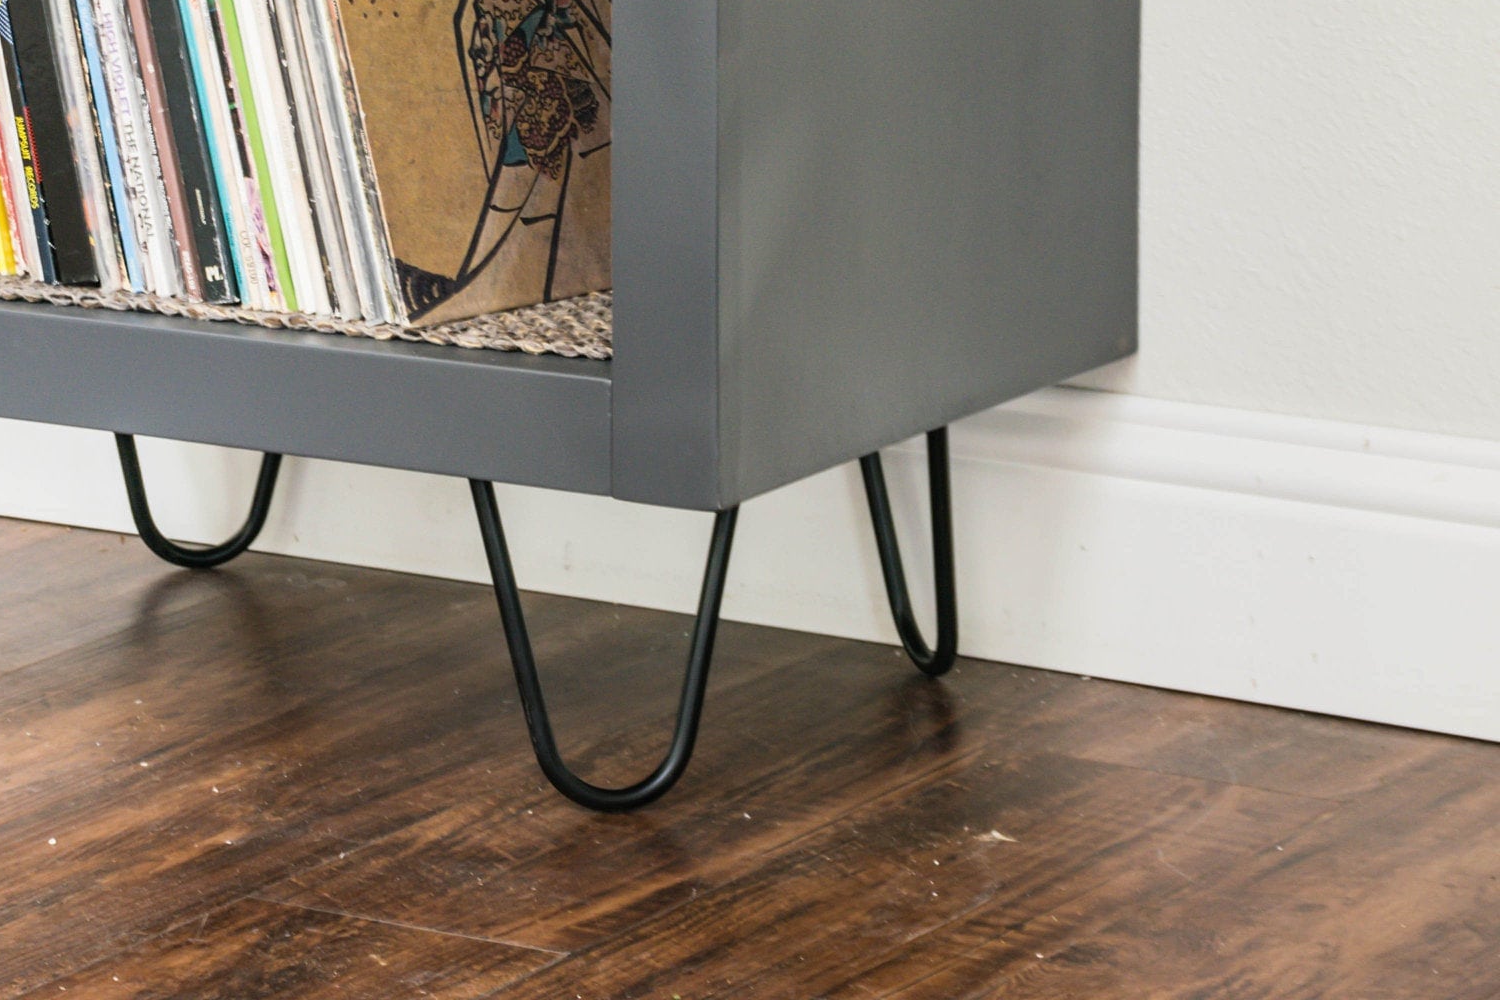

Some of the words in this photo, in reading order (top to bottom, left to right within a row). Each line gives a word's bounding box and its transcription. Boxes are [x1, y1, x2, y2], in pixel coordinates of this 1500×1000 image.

[24, 166, 39, 208] RECORDS
[102, 14, 119, 53] HIGH
[112, 59, 131, 115] VIOLET
[122, 121, 138, 153] THE
[131, 157, 154, 238] NATIONAL
